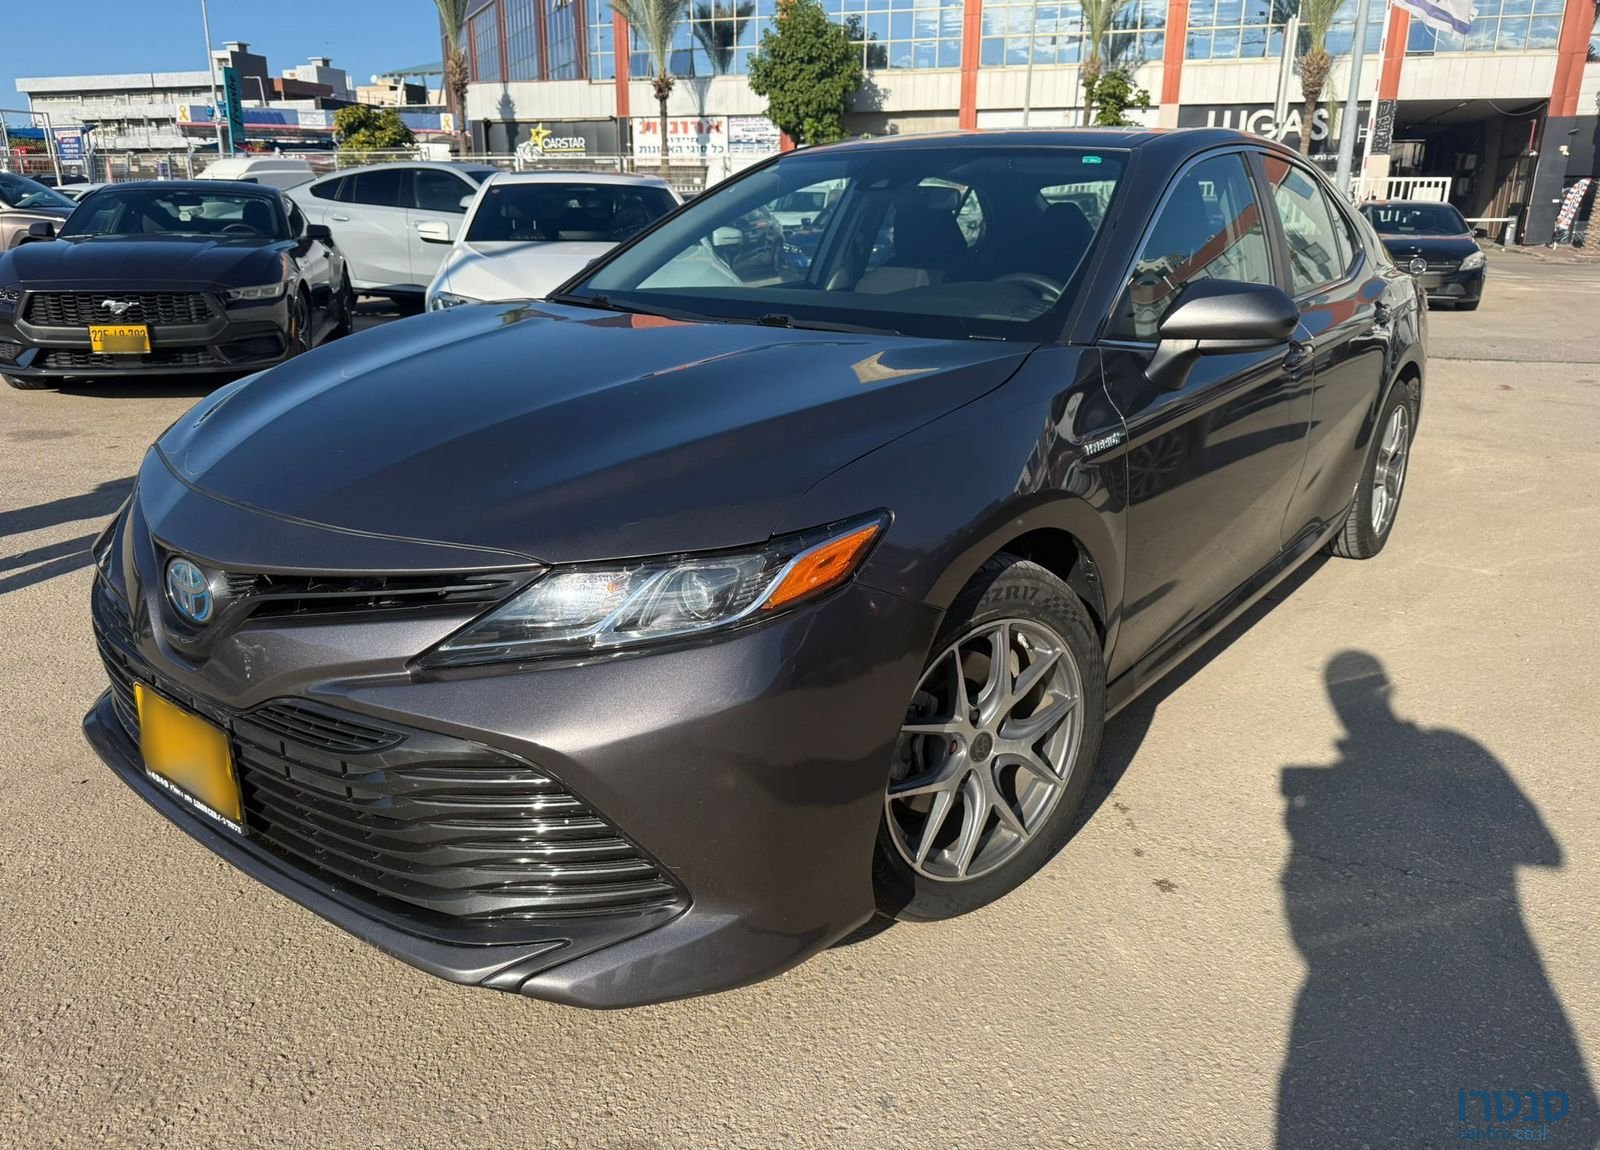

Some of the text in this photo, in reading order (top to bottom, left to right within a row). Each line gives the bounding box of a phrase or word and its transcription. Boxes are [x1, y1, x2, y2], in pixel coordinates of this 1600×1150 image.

[639, 120, 723, 135] ארונת
[542, 137, 586, 149] CARSTAR
[639, 145, 682, 153] האונות
[711, 144, 724, 153] כל
